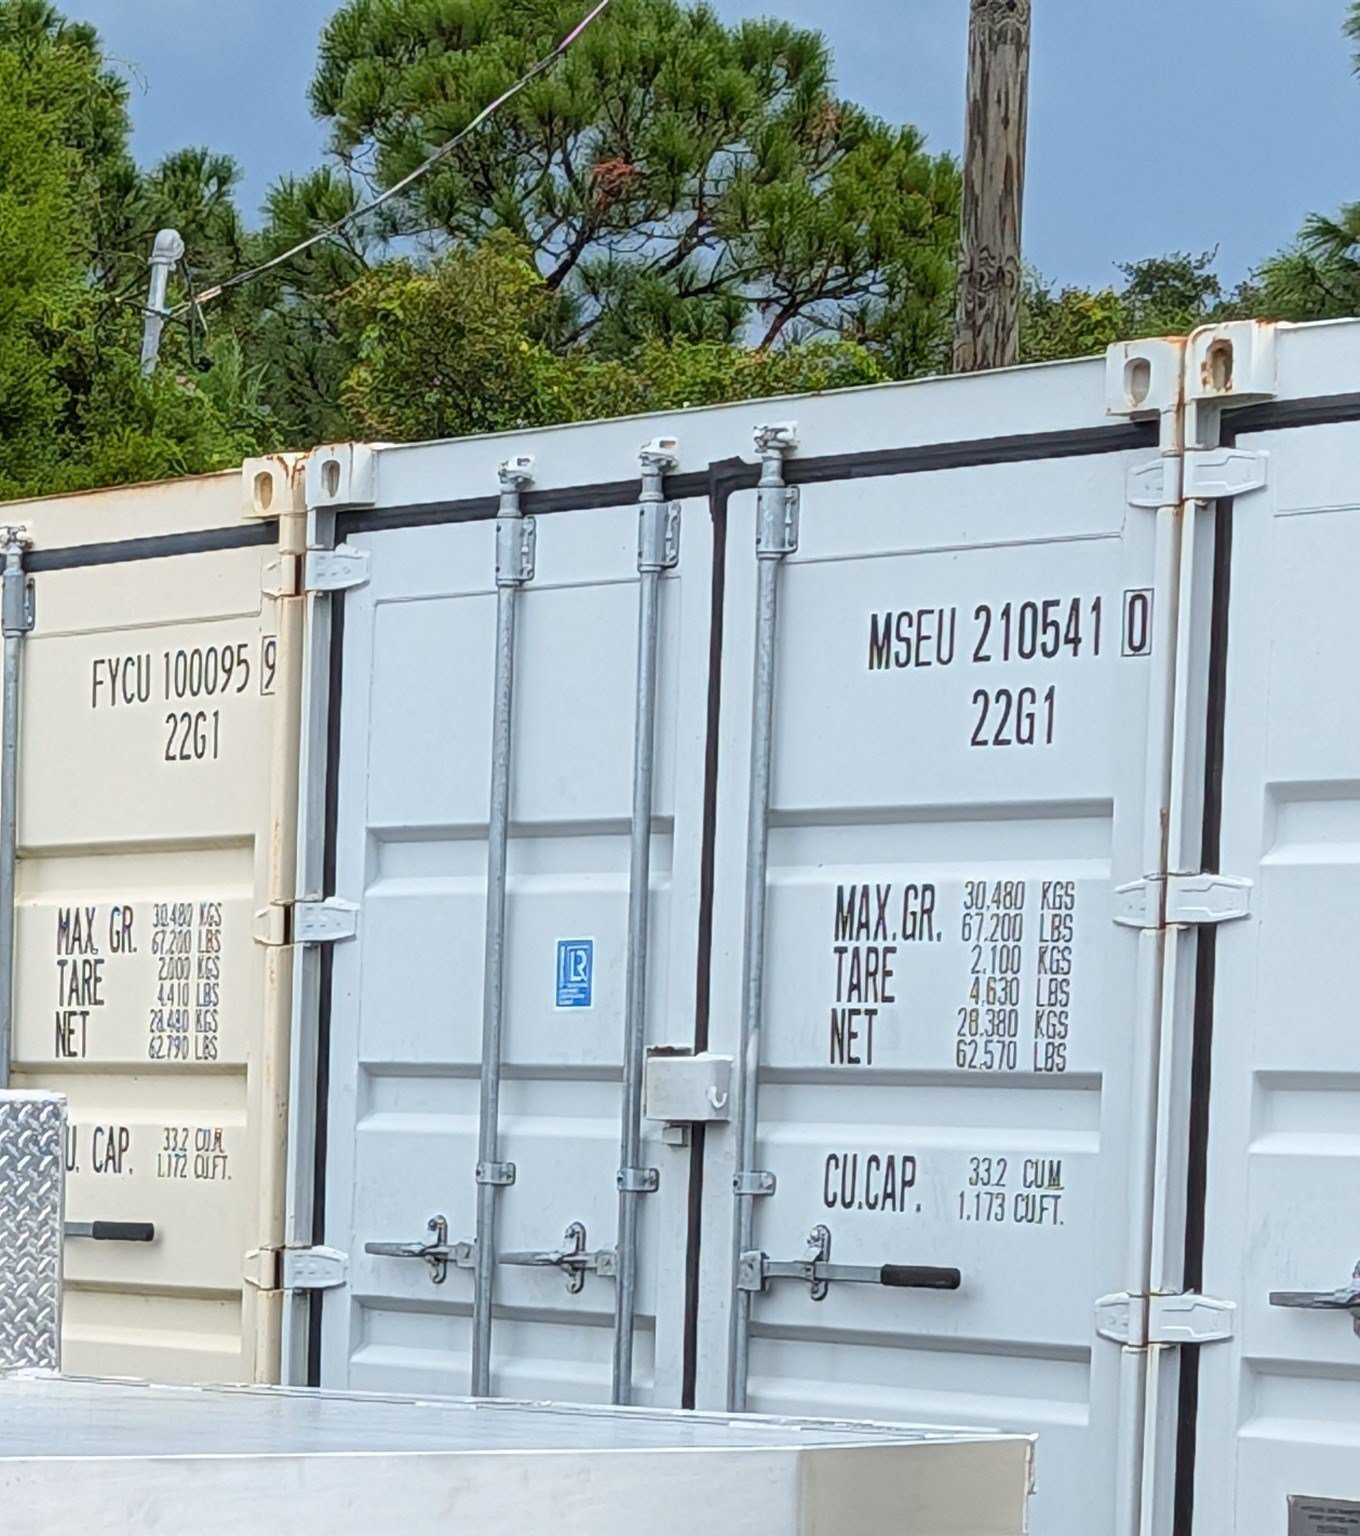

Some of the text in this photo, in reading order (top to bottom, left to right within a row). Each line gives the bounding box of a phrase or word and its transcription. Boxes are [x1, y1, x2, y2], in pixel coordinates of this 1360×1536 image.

[867, 591, 1151, 670] MSEU 210541 0
[91, 653, 151, 708] FYCU
[163, 643, 250, 700] 100095
[164, 709, 220, 761] 22G1
[970, 684, 1056, 747] 22G1
[1041, 881, 1075, 911] KGS
[109, 905, 138, 953] GR.
[198, 901, 222, 927] KGS
[197, 929, 222, 954] LBS
[1039, 913, 1073, 943] LBS
[56, 958, 105, 1007] TARE
[197, 955, 221, 981] KGS
[196, 982, 220, 1007] LBS
[833, 945, 897, 1004] TARE
[1037, 945, 1072, 976] KGS
[1036, 978, 1071, 1008] LBS
[55, 1010, 90, 1059] NET
[195, 1008, 219, 1034] KGS
[194, 1035, 218, 1061] LBS
[829, 1007, 879, 1065] NET
[1034, 1008, 1069, 1039] KGS
[1033, 1041, 1068, 1073] LBS
[92, 1125, 134, 1175] CAP.
